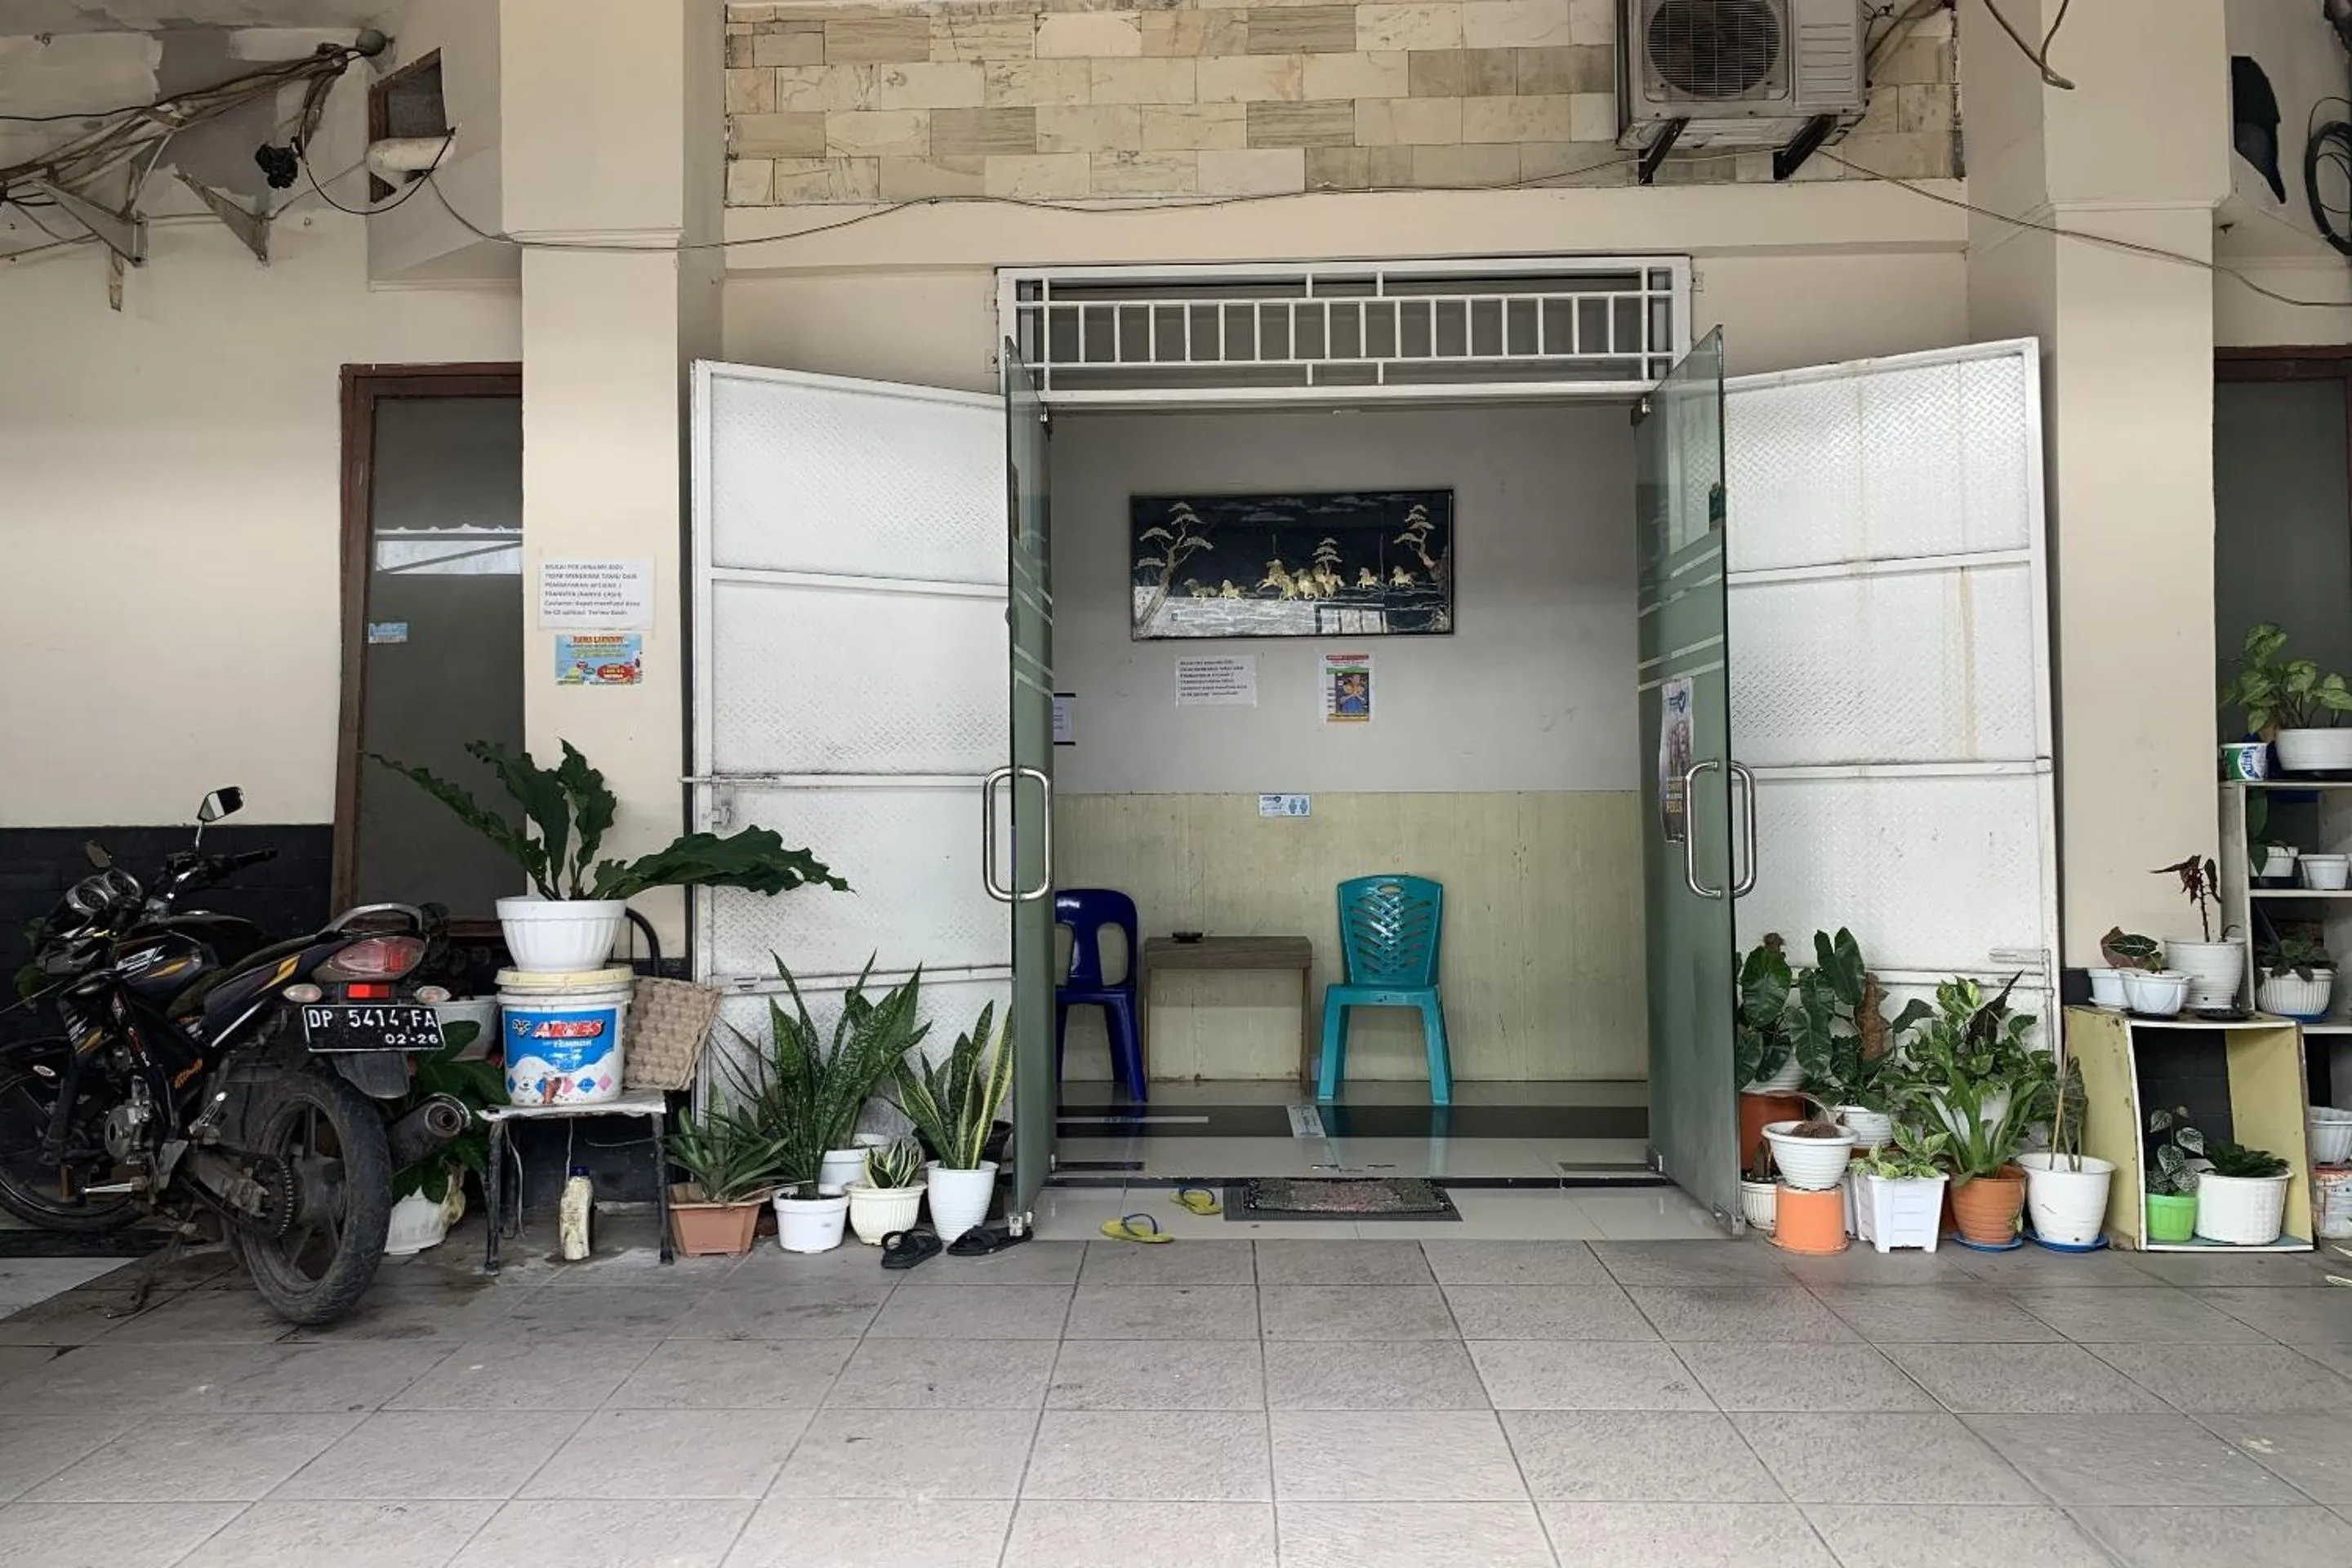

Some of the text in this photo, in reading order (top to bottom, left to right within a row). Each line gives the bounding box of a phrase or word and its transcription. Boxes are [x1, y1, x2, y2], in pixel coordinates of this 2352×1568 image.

[309, 1009, 438, 1027] DP 5414 FA
